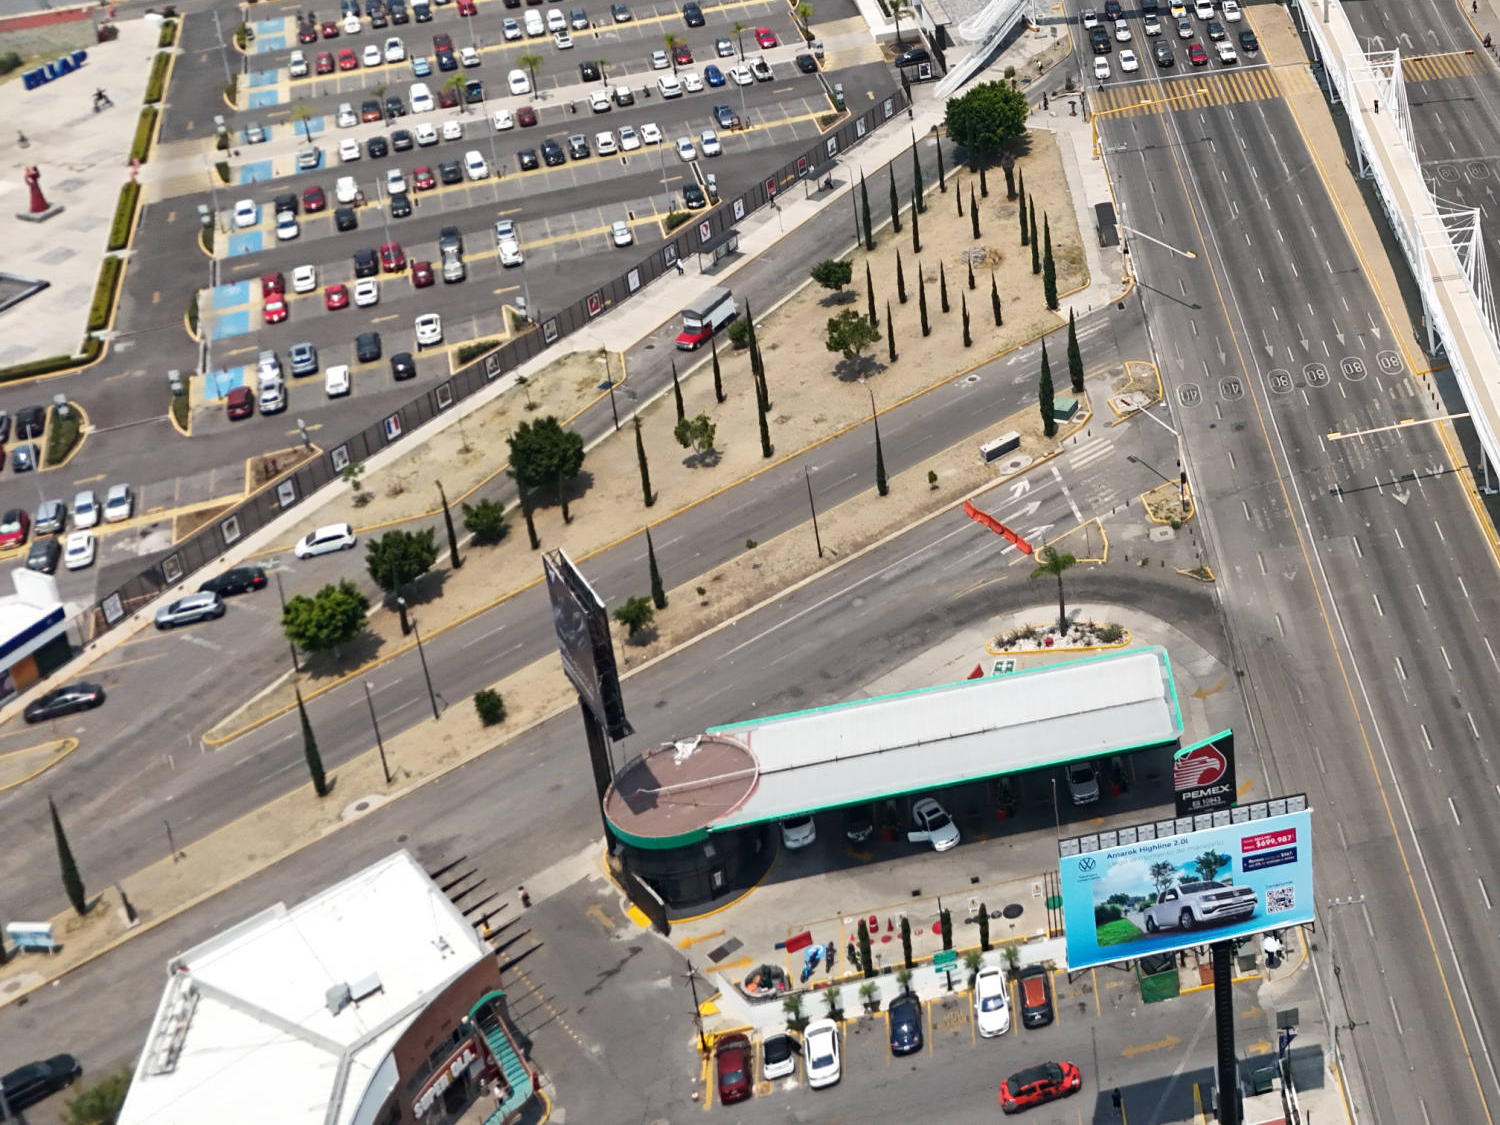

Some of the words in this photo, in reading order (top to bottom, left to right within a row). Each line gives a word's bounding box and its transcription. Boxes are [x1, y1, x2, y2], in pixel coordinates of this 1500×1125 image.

[21, 49, 88, 92] BUAP
[1182, 784, 1230, 801] PEMEX
[1106, 848, 1137, 860] Amarok
[1139, 841, 1172, 853] Highline
